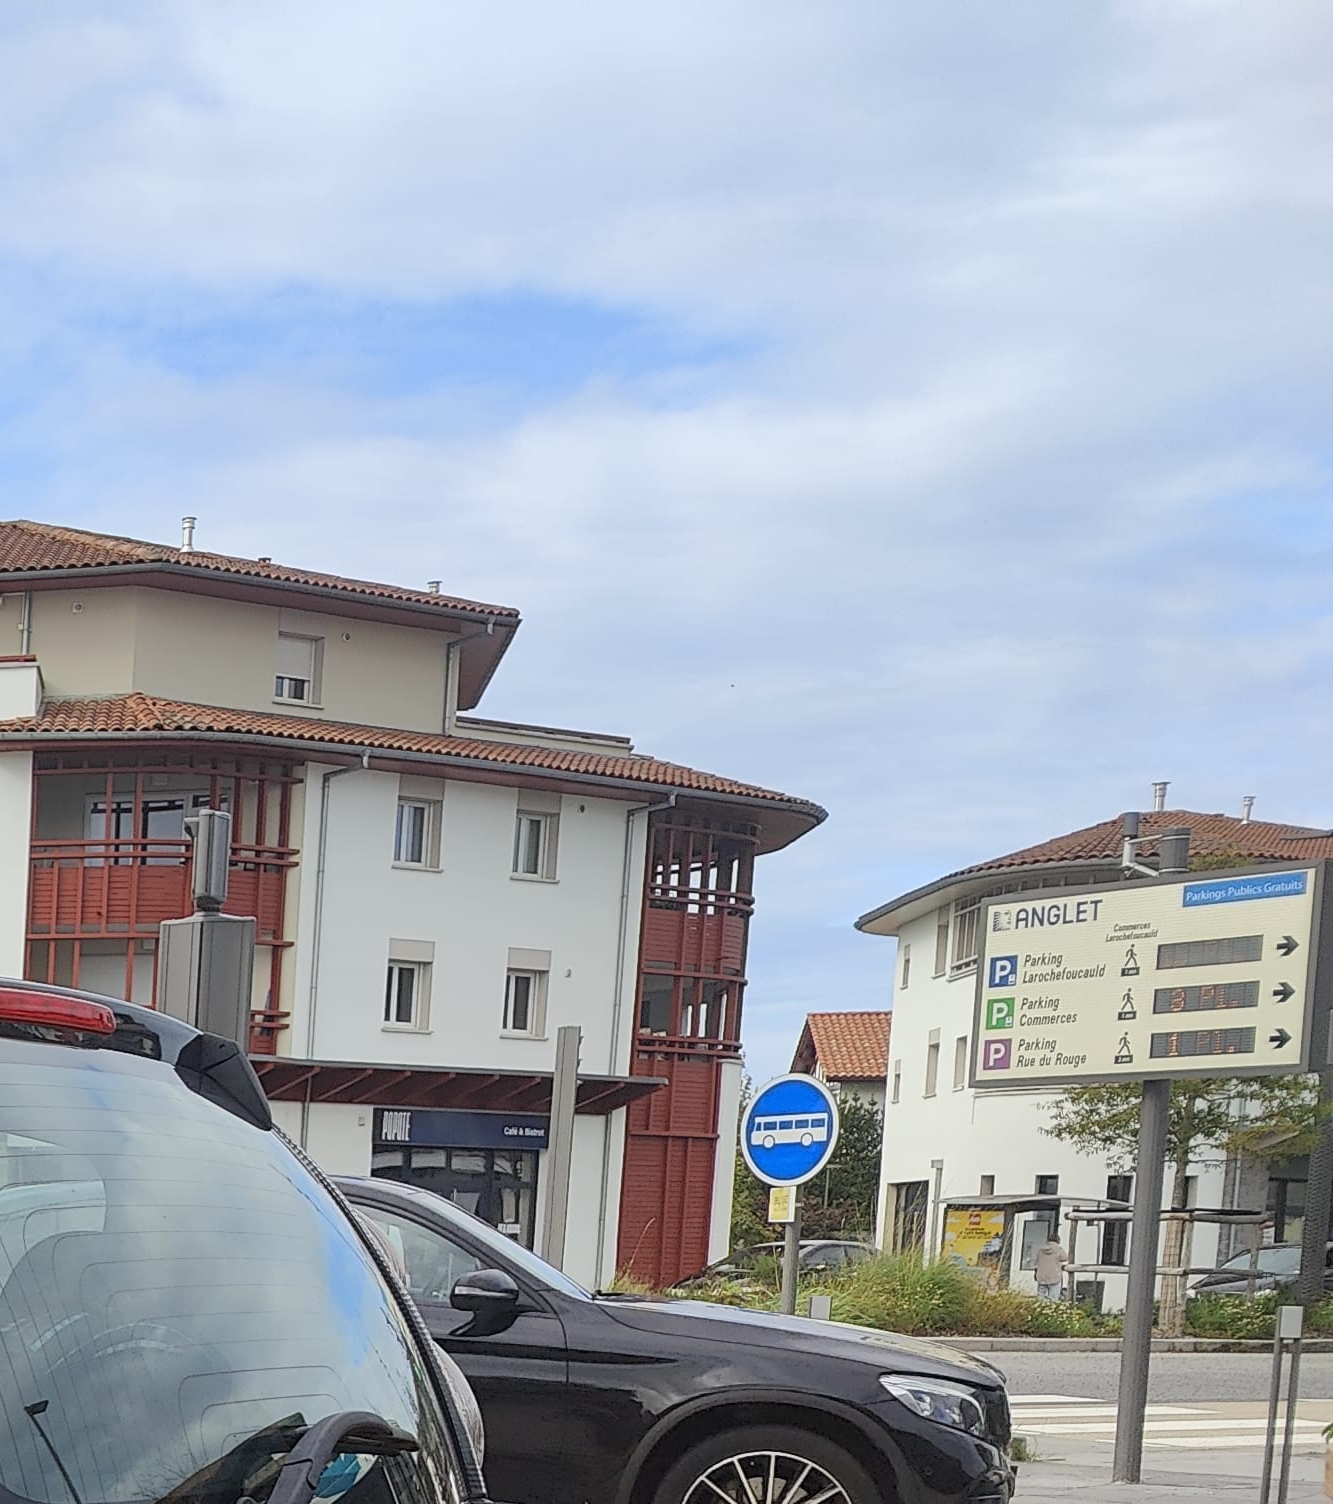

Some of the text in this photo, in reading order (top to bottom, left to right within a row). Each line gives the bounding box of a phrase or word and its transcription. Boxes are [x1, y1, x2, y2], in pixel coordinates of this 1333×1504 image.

[1185, 879, 1303, 903] Parkings Publics Gratuits
[1015, 899, 1103, 929] ANGLET
[1113, 922, 1151, 932] Commerces
[1023, 952, 1063, 968] Parking
[1022, 964, 1106, 985] Larochefoucauld
[1020, 996, 1060, 1012] Parking
[1019, 1012, 1078, 1027] Commerces
[1017, 1038, 1057, 1052] Parking
[1016, 1052, 1087, 1068] Rue du Rouge
[382, 1111, 411, 1141] POPOTE
